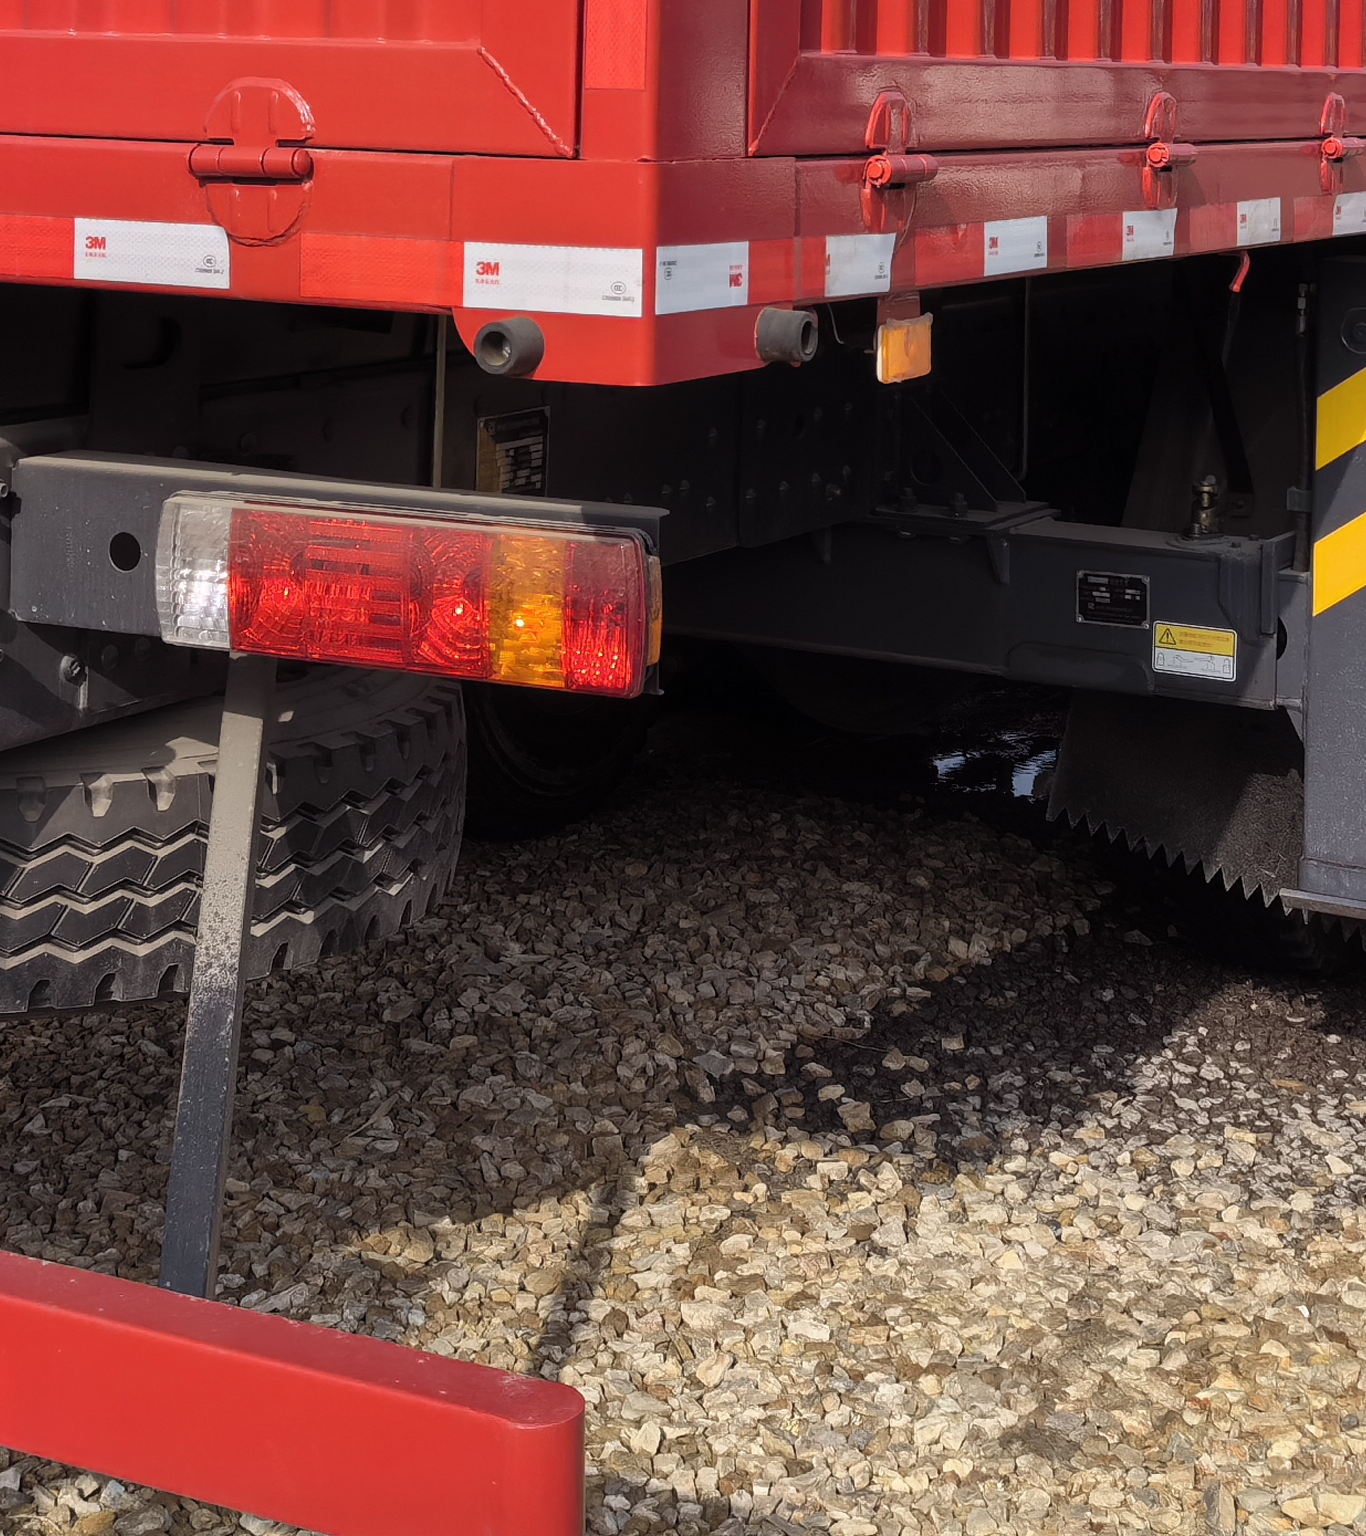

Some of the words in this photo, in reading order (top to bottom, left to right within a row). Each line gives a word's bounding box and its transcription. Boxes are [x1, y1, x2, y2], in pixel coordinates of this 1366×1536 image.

[85, 236, 106, 250] 3M
[476, 261, 500, 276] 3M
[729, 272, 742, 288] 3M
